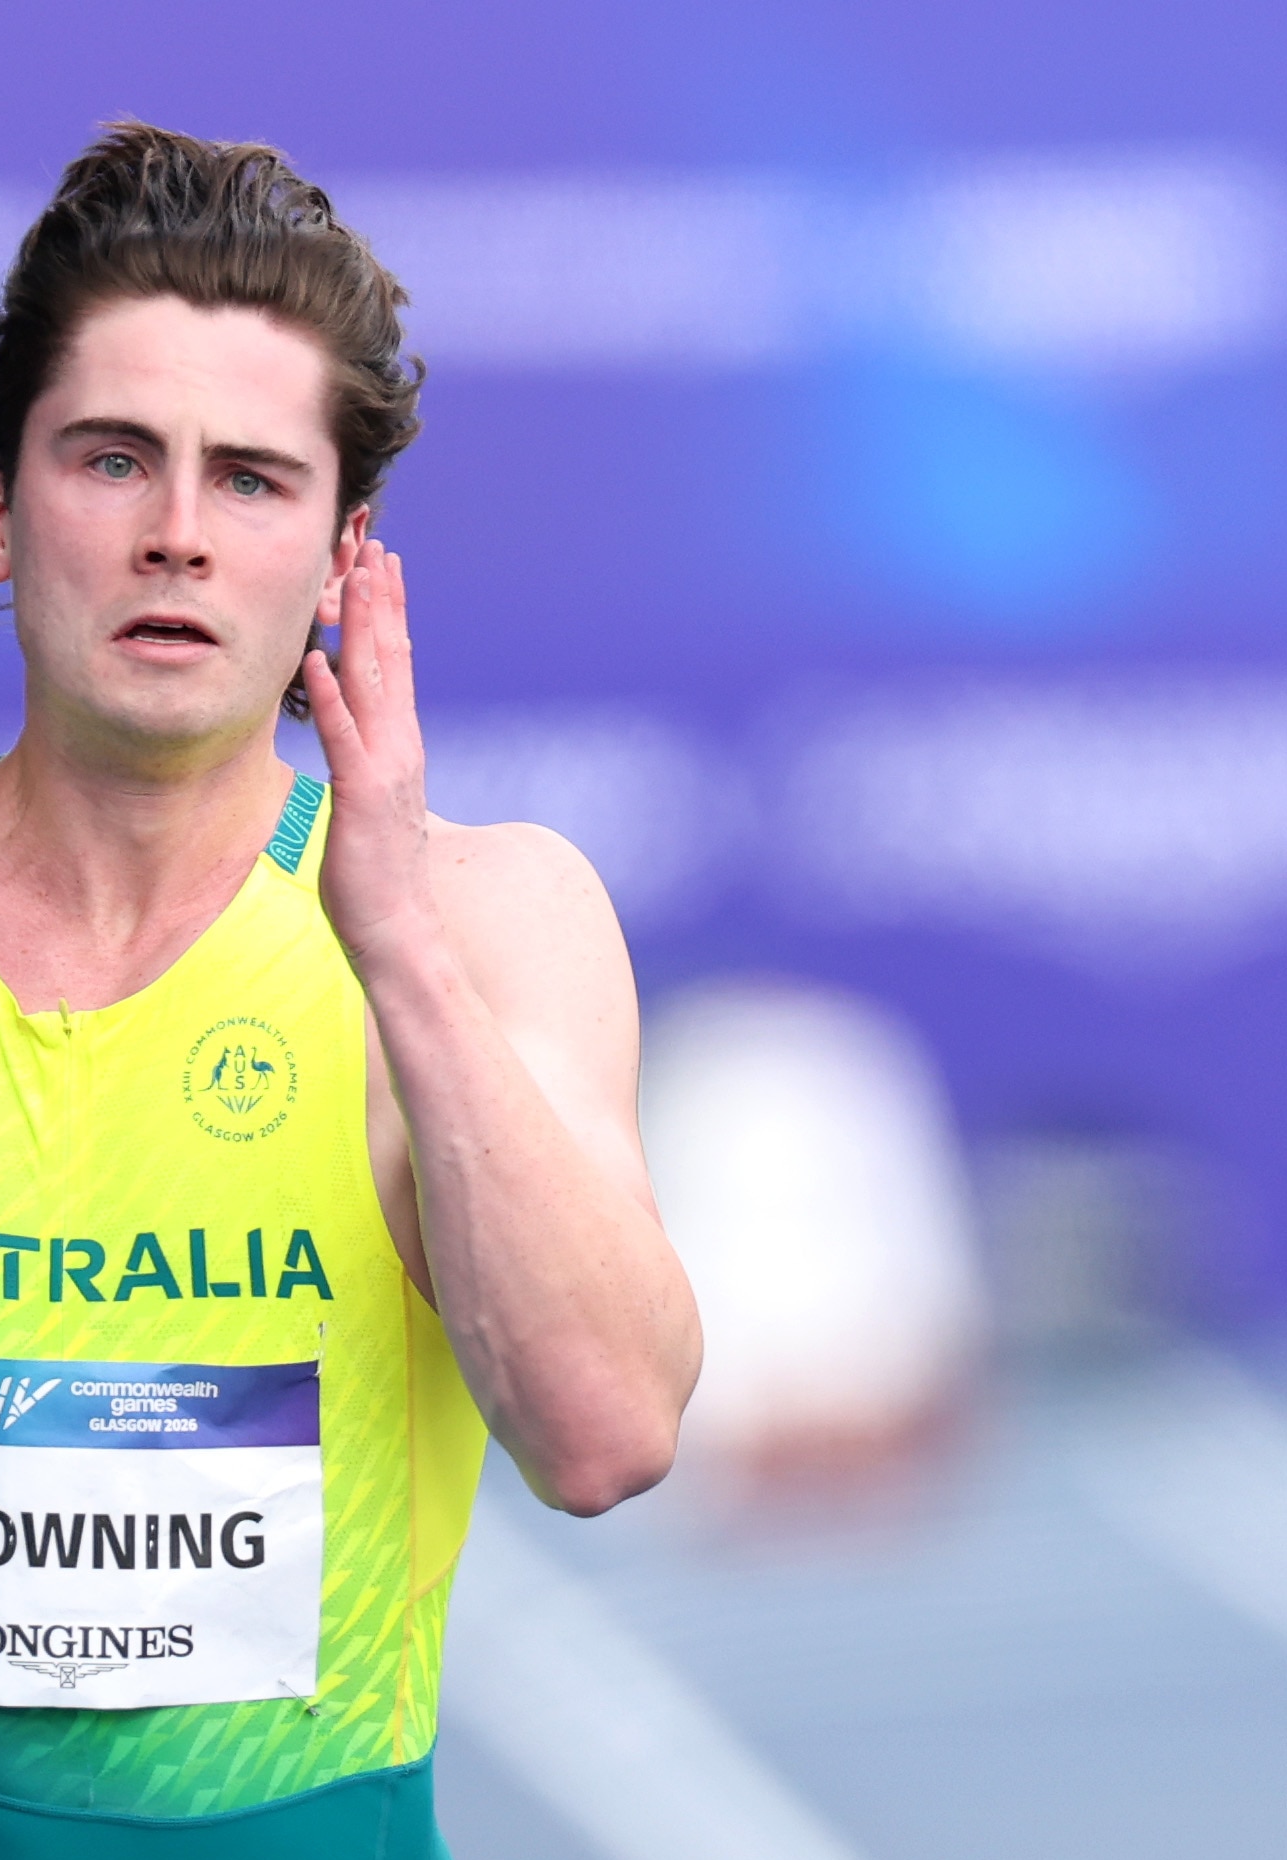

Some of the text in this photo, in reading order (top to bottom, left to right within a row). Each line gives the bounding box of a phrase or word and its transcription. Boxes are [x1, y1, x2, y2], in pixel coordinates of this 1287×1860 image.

[186, 1016, 287, 1064] COMMONWEALTH
[285, 1051, 297, 1103] GAMES
[192, 1110, 288, 1142] GLASGOW 2026
[70, 1381, 219, 1398] commonwealth
[110, 1397, 178, 1416] games
[89, 1417, 199, 1432] GLASGOW 2026
